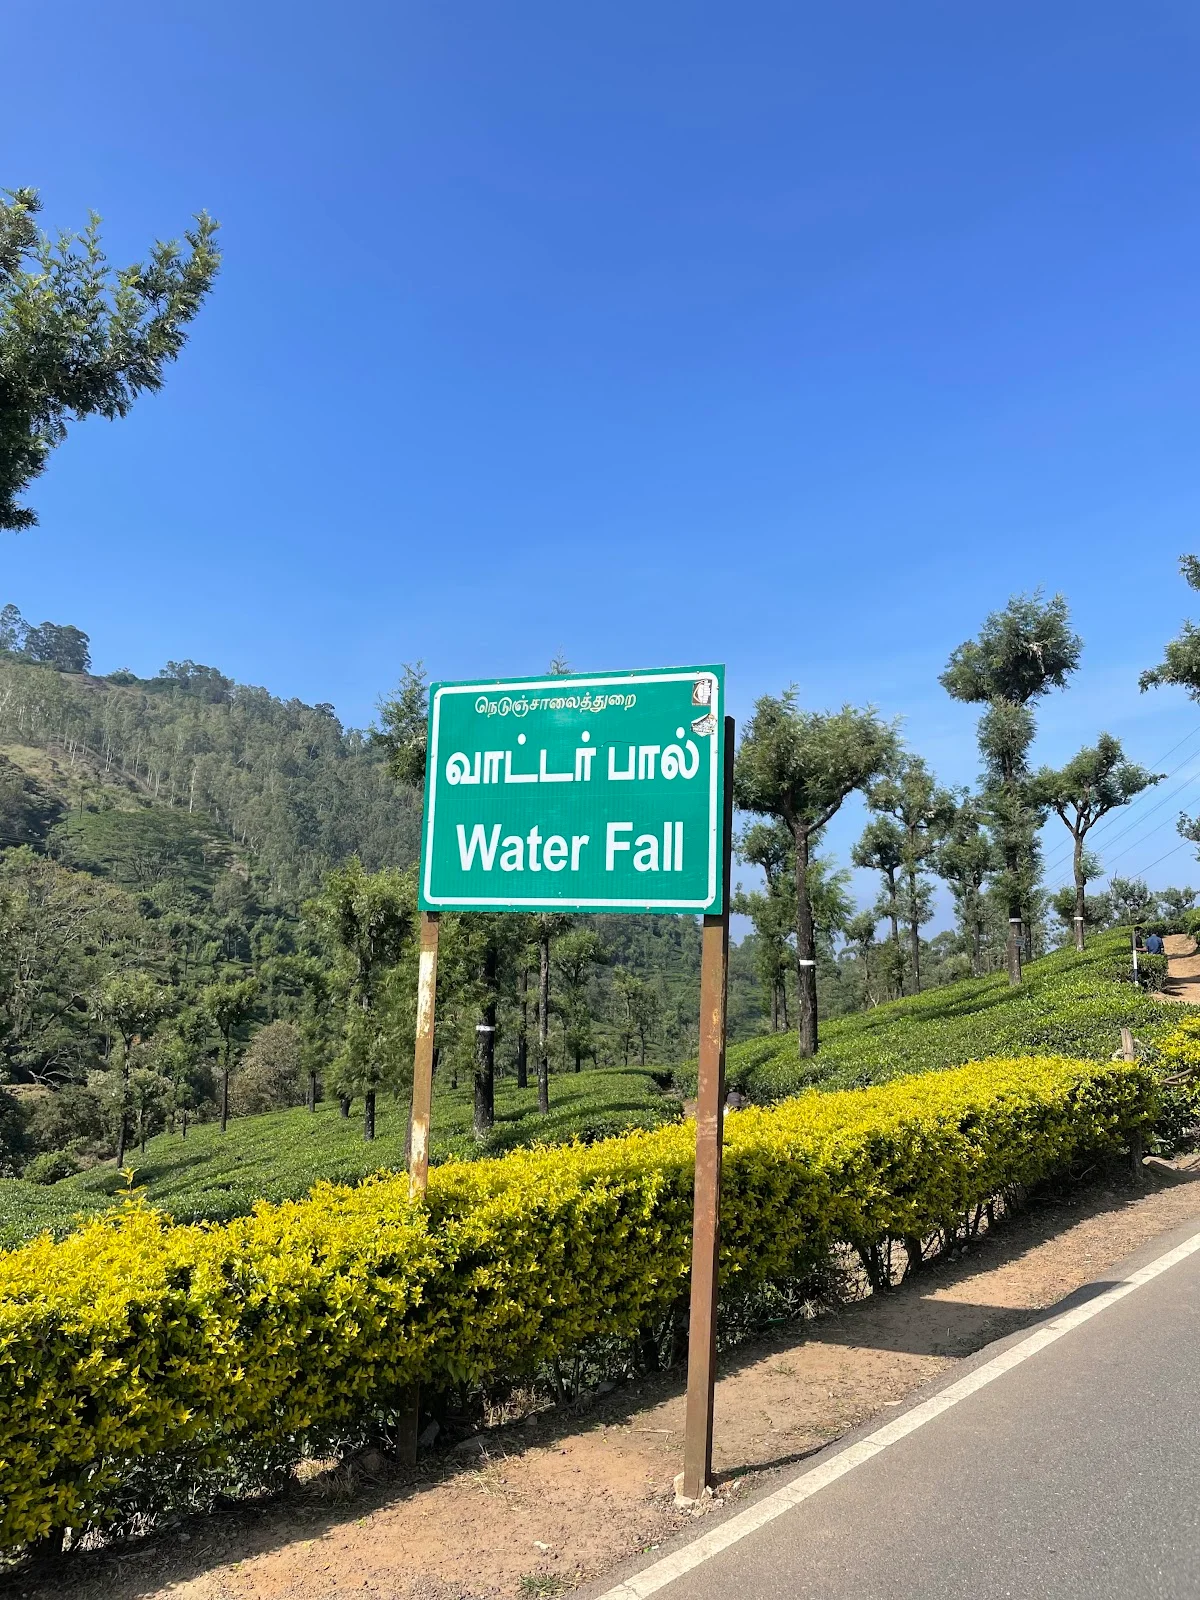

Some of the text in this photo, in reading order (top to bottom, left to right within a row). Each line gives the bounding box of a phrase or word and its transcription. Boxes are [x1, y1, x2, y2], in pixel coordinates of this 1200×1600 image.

[474, 692, 637, 718] நெடுஞ்சாலைத்துறை
[445, 727, 700, 785] வாட்டர் பால்
[456, 821, 684, 872] Water Fall
